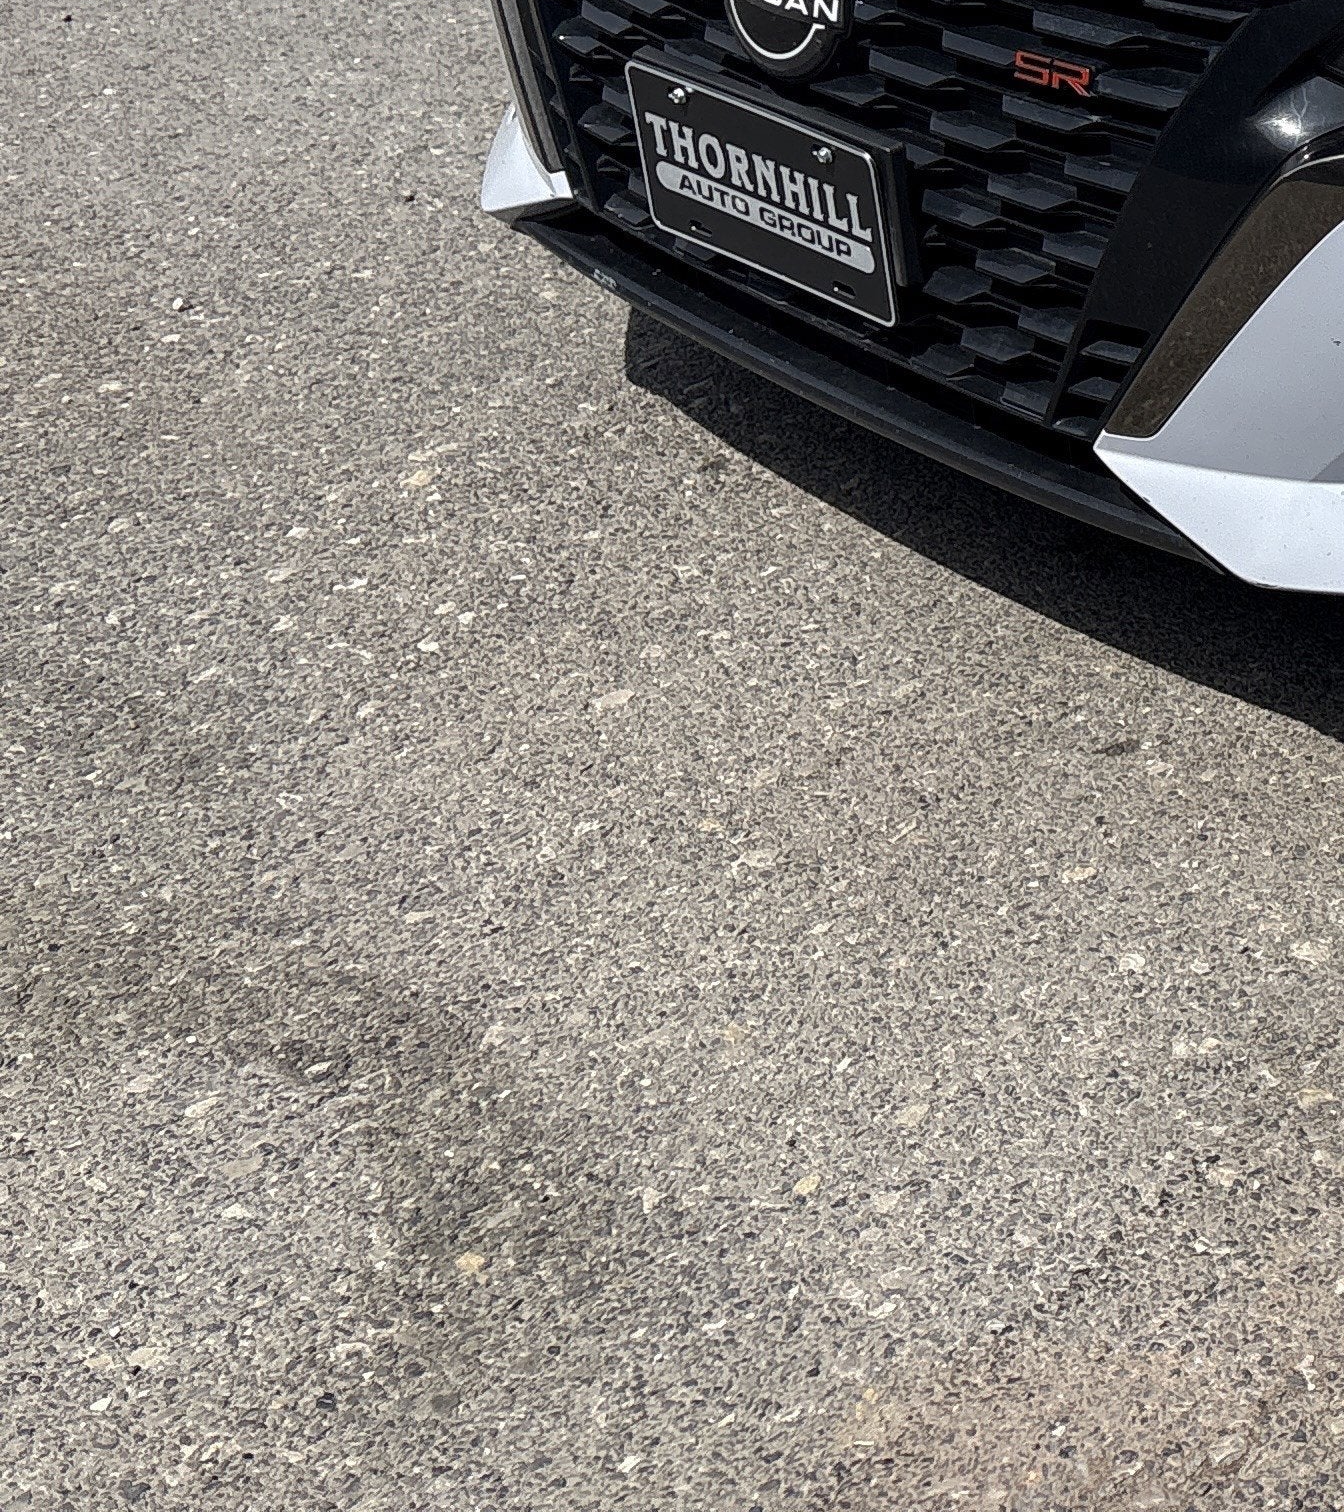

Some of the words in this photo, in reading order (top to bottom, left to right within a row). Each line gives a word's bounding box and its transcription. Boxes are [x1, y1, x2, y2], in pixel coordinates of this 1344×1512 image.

[1013, 49, 1092, 99] SR
[644, 111, 873, 243] THORNHILL
[678, 173, 751, 217] AUTO
[758, 206, 852, 258] GROUP
